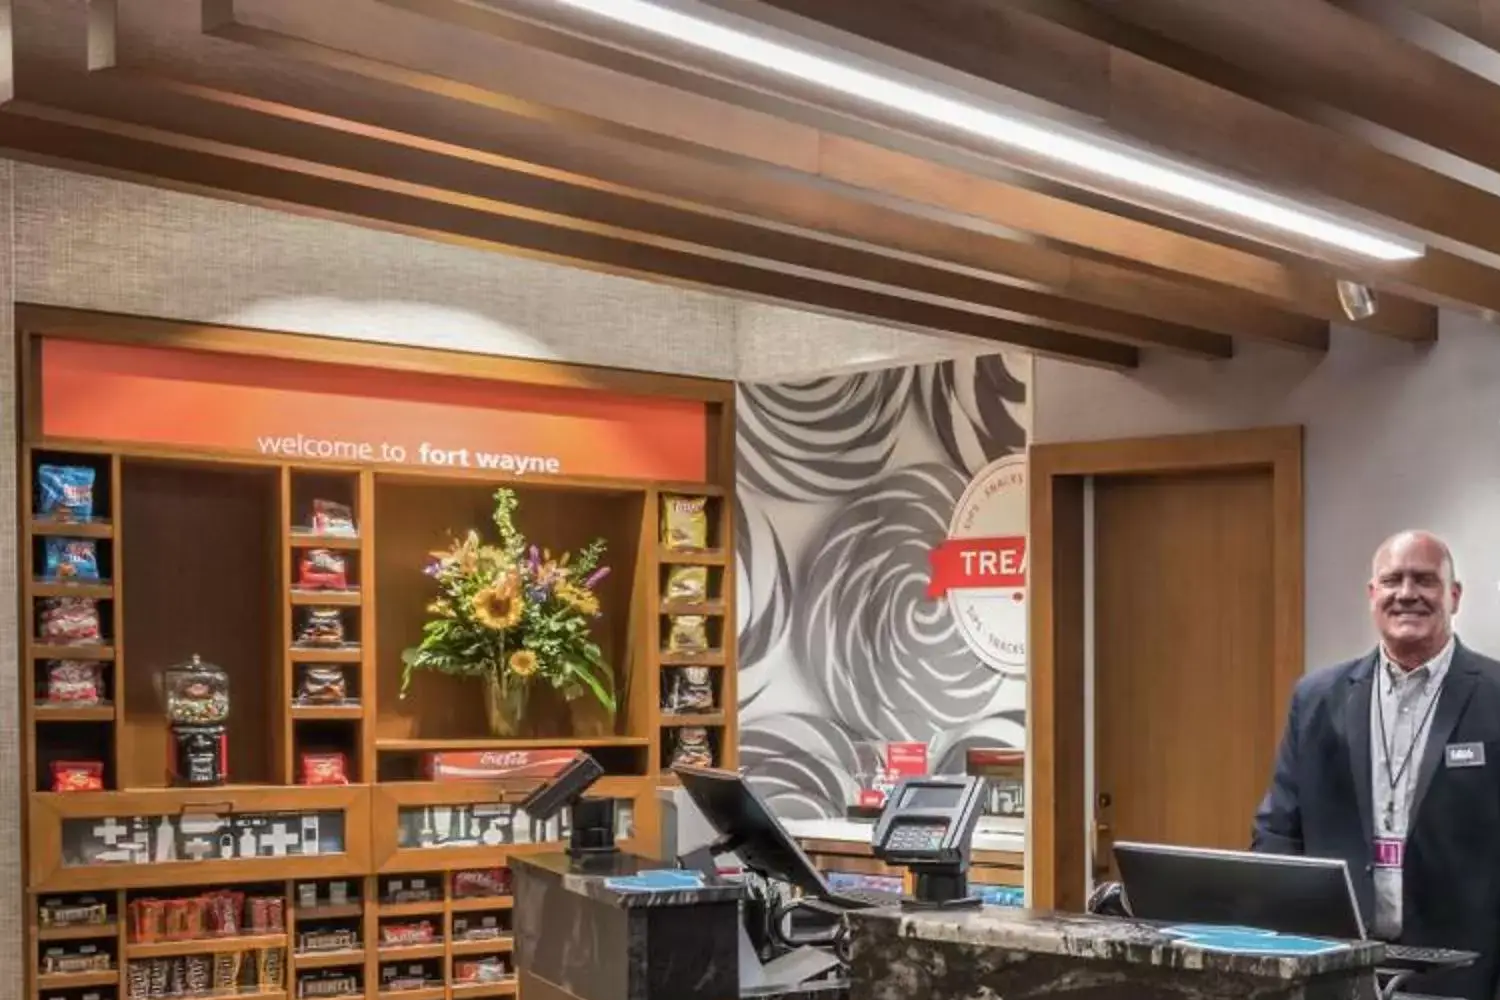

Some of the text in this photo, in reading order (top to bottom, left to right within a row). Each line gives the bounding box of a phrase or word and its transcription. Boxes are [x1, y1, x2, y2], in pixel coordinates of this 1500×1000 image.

[257, 433, 560, 476] welcome to fort wayne
